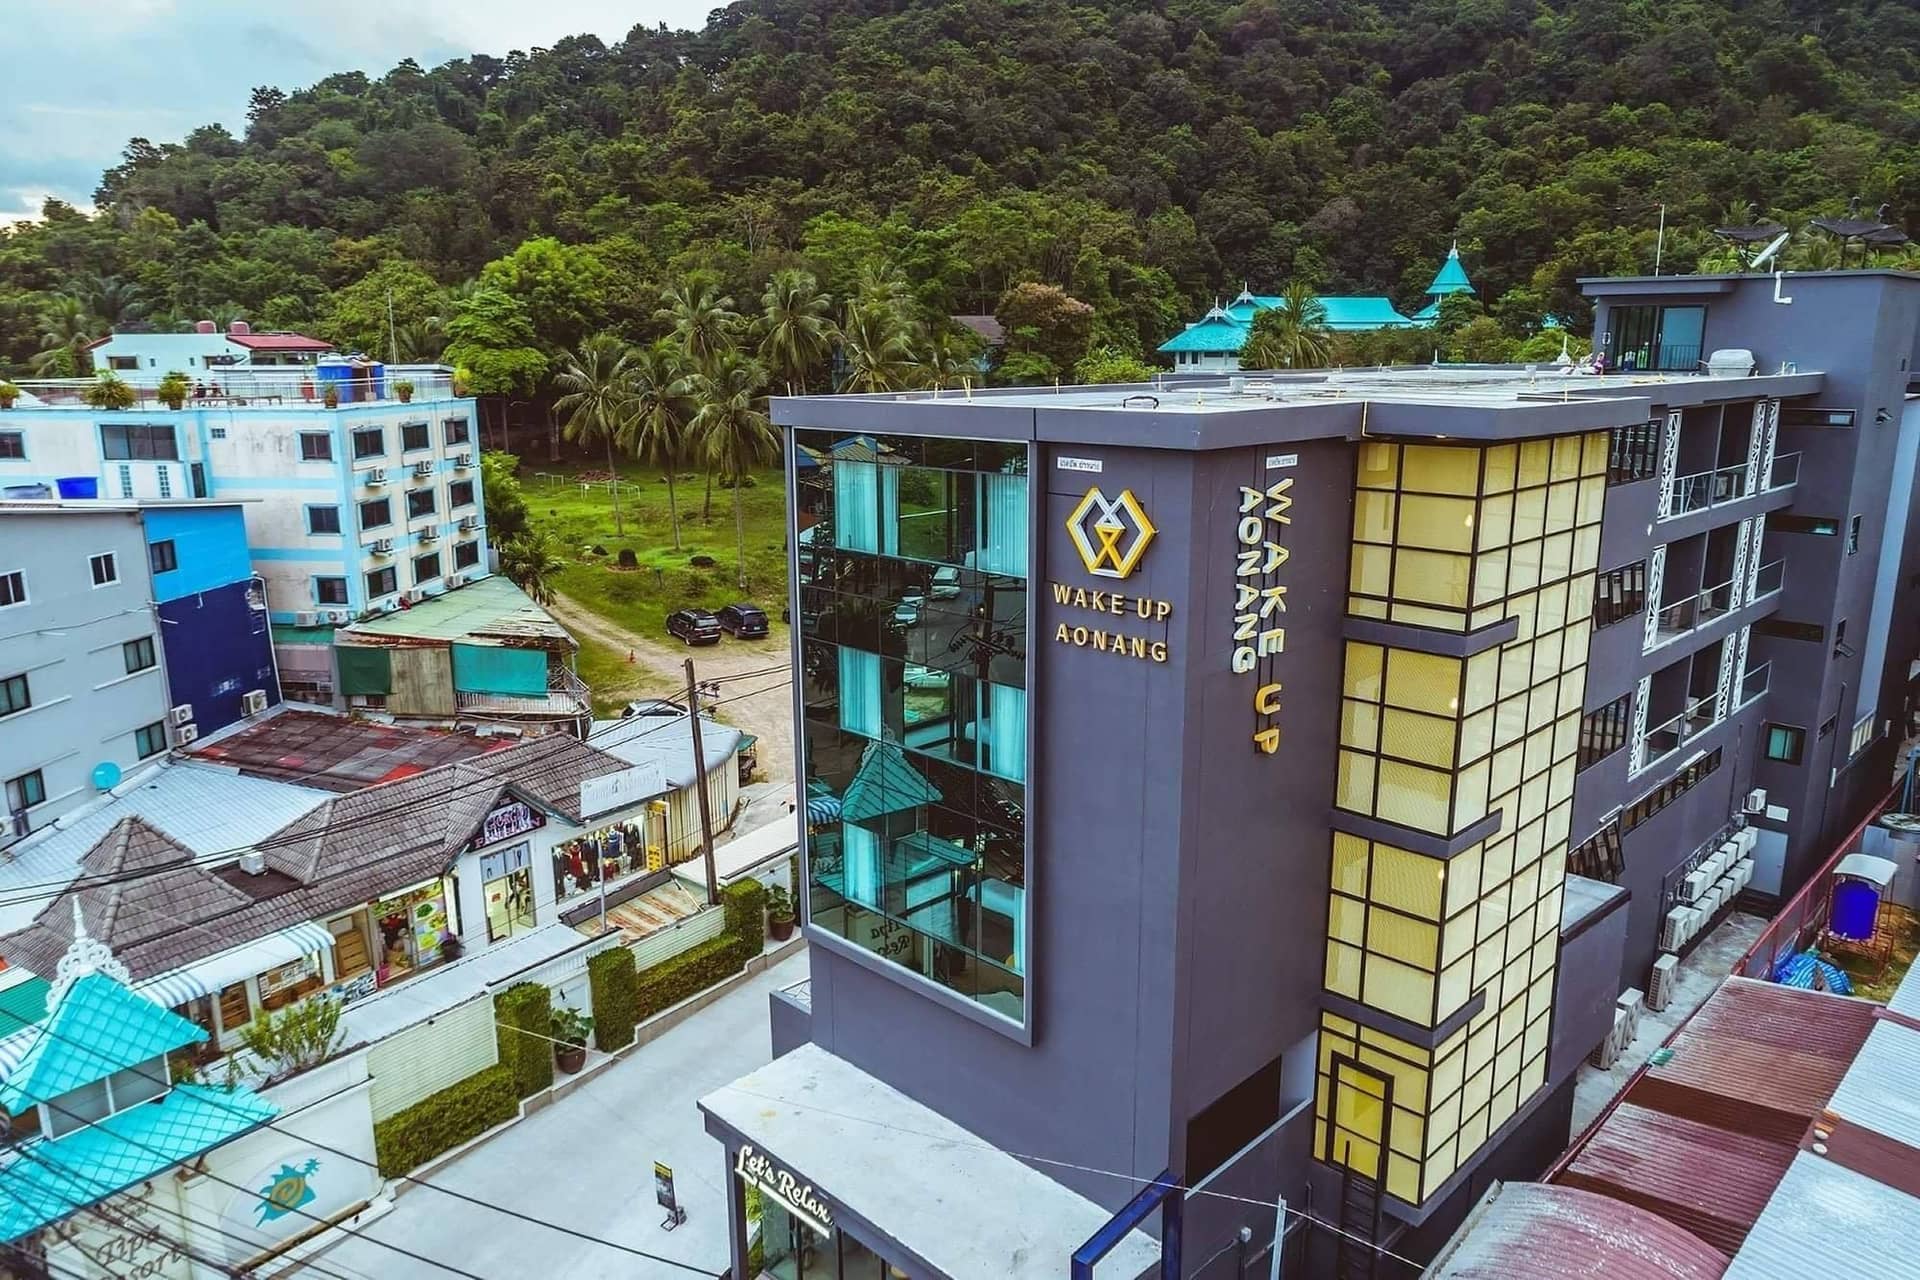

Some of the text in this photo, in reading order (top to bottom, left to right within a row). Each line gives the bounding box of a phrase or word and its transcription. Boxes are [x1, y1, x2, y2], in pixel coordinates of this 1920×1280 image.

[1232, 486, 1265, 673] AONANG
[1258, 478, 1294, 657] WAKE
[1053, 582, 1172, 622] WAKE UP
[1055, 623, 1168, 663] AONANG
[1254, 683, 1282, 754] UP
[734, 1144, 777, 1187] Let's
